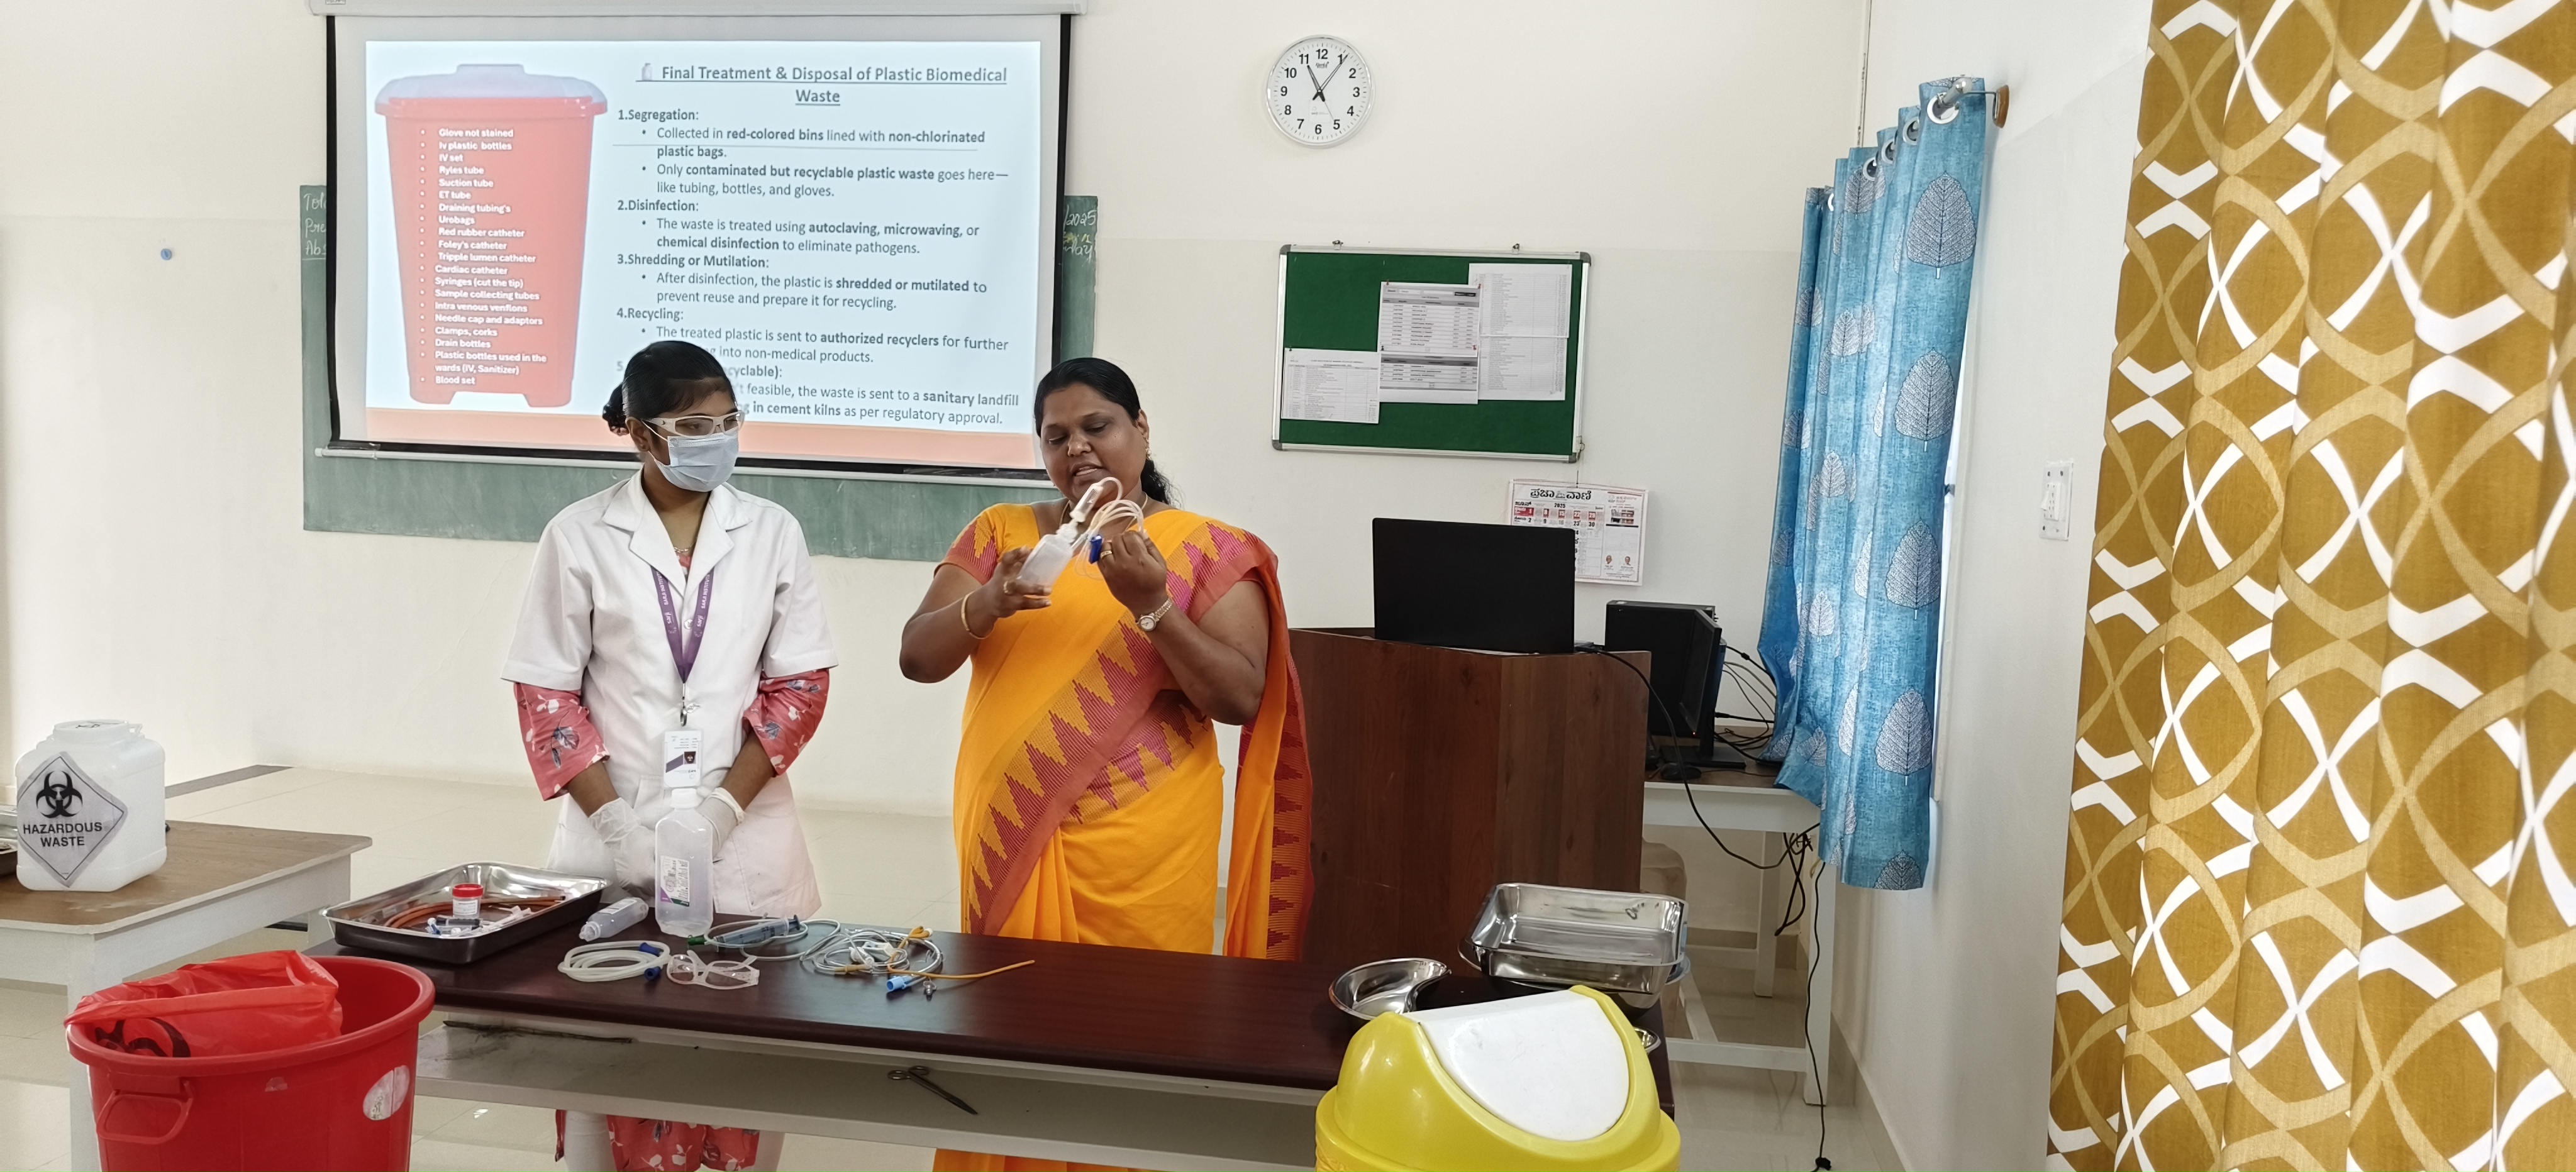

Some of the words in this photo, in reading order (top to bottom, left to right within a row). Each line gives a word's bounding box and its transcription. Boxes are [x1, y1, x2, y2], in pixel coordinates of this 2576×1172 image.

[1299, 53, 1309, 64] 11
[1316, 49, 1328, 60] 12
[1338, 53, 1343, 64] 1
[662, 65, 694, 79] Final
[697, 67, 772, 79] Treatment
[775, 67, 788, 80] &
[792, 67, 852, 82] Disposal
[856, 67, 872, 80] of
[875, 66, 923, 81] Plastic
[926, 67, 1007, 81] Biomedical
[1284, 68, 1297, 78] 10
[1349, 68, 1357, 79] 2
[795, 90, 840, 102] Waste
[1280, 86, 1287, 96] 9
[1353, 87, 1360, 97] 3
[618, 108, 699, 123] 1.Segregation:
[1284, 105, 1292, 115] 8
[1346, 106, 1354, 116] 4
[1297, 118, 1304, 129] 7
[1333, 119, 1340, 130] 5
[438, 128, 464, 138] Glove
[465, 128, 480, 137] not
[481, 128, 514, 138] stained
[657, 127, 709, 138] Collected
[713, 128, 723, 139] in
[726, 128, 796, 140] red-colored
[799, 128, 824, 141] bins
[827, 130, 855, 141] lined
[858, 130, 885, 141] with
[889, 130, 985, 143] non-chlorinated
[1315, 124, 1322, 135] 6
[439, 141, 447, 150] Iv
[448, 141, 478, 152] plastic
[481, 141, 512, 151] bottles
[657, 145, 694, 158] plastic
[697, 146, 727, 158] bags.
[439, 153, 448, 162] IV
[449, 153, 464, 162] set
[439, 165, 463, 176] Ryles
[464, 166, 484, 174] tube
[657, 163, 683, 177] Only
[686, 163, 767, 176] contaminated
[770, 164, 791, 177] but
[794, 167, 854, 180] recyclable
[857, 167, 896, 181] plastic
[898, 169, 935, 180] waste
[937, 171, 965, 182] goes
[438, 178, 472, 187] Suction
[473, 179, 494, 187] tube
[438, 190, 450, 199] ET
[451, 191, 471, 199] tube
[657, 182, 676, 193] like
[679, 182, 719, 196] tubing,
[722, 182, 765, 196] bottles,
[769, 184, 791, 196] and
[794, 185, 835, 199] gloves.
[617, 199, 699, 211] 2.Disinfection:
[438, 215, 475, 226] Urobags
[657, 218, 678, 229] The
[680, 219, 714, 229] waste
[717, 219, 726, 231] is
[729, 220, 772, 231] treated
[775, 221, 806, 235] using
[808, 222, 880, 237] autoclaving,
[884, 223, 963, 238] microwaving,
[966, 227, 980, 236] or
[438, 240, 469, 251] Foley's
[470, 241, 507, 250] catheter
[657, 236, 708, 248] chemical
[710, 236, 779, 250] disinfection
[782, 240, 795, 251] to
[798, 240, 852, 252] eliminate
[855, 241, 920, 256] pathogens.
[617, 253, 685, 268] 3.Shredding
[687, 257, 701, 266] or
[704, 255, 769, 268] Mutilation:
[656, 272, 686, 284] After
[688, 272, 758, 288] disinfection,
[761, 275, 780, 287] the
[784, 275, 821, 290] plastic
[824, 277, 833, 289] is
[836, 277, 892, 290] shredded
[895, 282, 909, 290] or
[911, 279, 969, 292] mutilated
[973, 282, 987, 293] to
[657, 292, 700, 304] prevent
[703, 294, 735, 303] reuse
[738, 292, 759, 304] and
[763, 296, 808, 307] prepare
[811, 294, 819, 306] it
[823, 295, 840, 306] for
[842, 297, 896, 311] recycling.
[616, 307, 684, 322] 4.Recycling:
[435, 338, 458, 347] Drain
[459, 338, 491, 348] bottles
[656, 326, 677, 338] The
[680, 328, 721, 339] treated
[725, 328, 762, 341] plastic
[765, 329, 774, 341] is
[777, 332, 802, 342] sent
[805, 331, 817, 343] to
[820, 332, 884, 345] authorized
[887, 334, 939, 348] recyclers
[942, 335, 960, 347] for
[963, 336, 1009, 350] further
[719, 346, 741, 358] into
[745, 348, 816, 360] non-medical
[819, 350, 874, 363] products.
[435, 375, 460, 384] Blood
[461, 376, 475, 385] set
[747, 383, 794, 398] feasible,
[798, 385, 817, 397] the
[820, 388, 854, 398] waste
[857, 387, 866, 399] is
[869, 389, 894, 400] sent
[897, 390, 910, 401] to
[913, 392, 919, 401] a
[923, 390, 975, 406] sanitary
[978, 393, 1019, 406] landfill
[753, 401, 764, 412] in
[767, 404, 811, 414] cement
[814, 403, 841, 416] kilns
[844, 408, 857, 417] as
[860, 408, 880, 420] per
[882, 407, 945, 424] regulatory
[948, 412, 1002, 425] approval.
[23, 822, 103, 834] HAZARDOUS
[40, 836, 85, 848] WASTE
